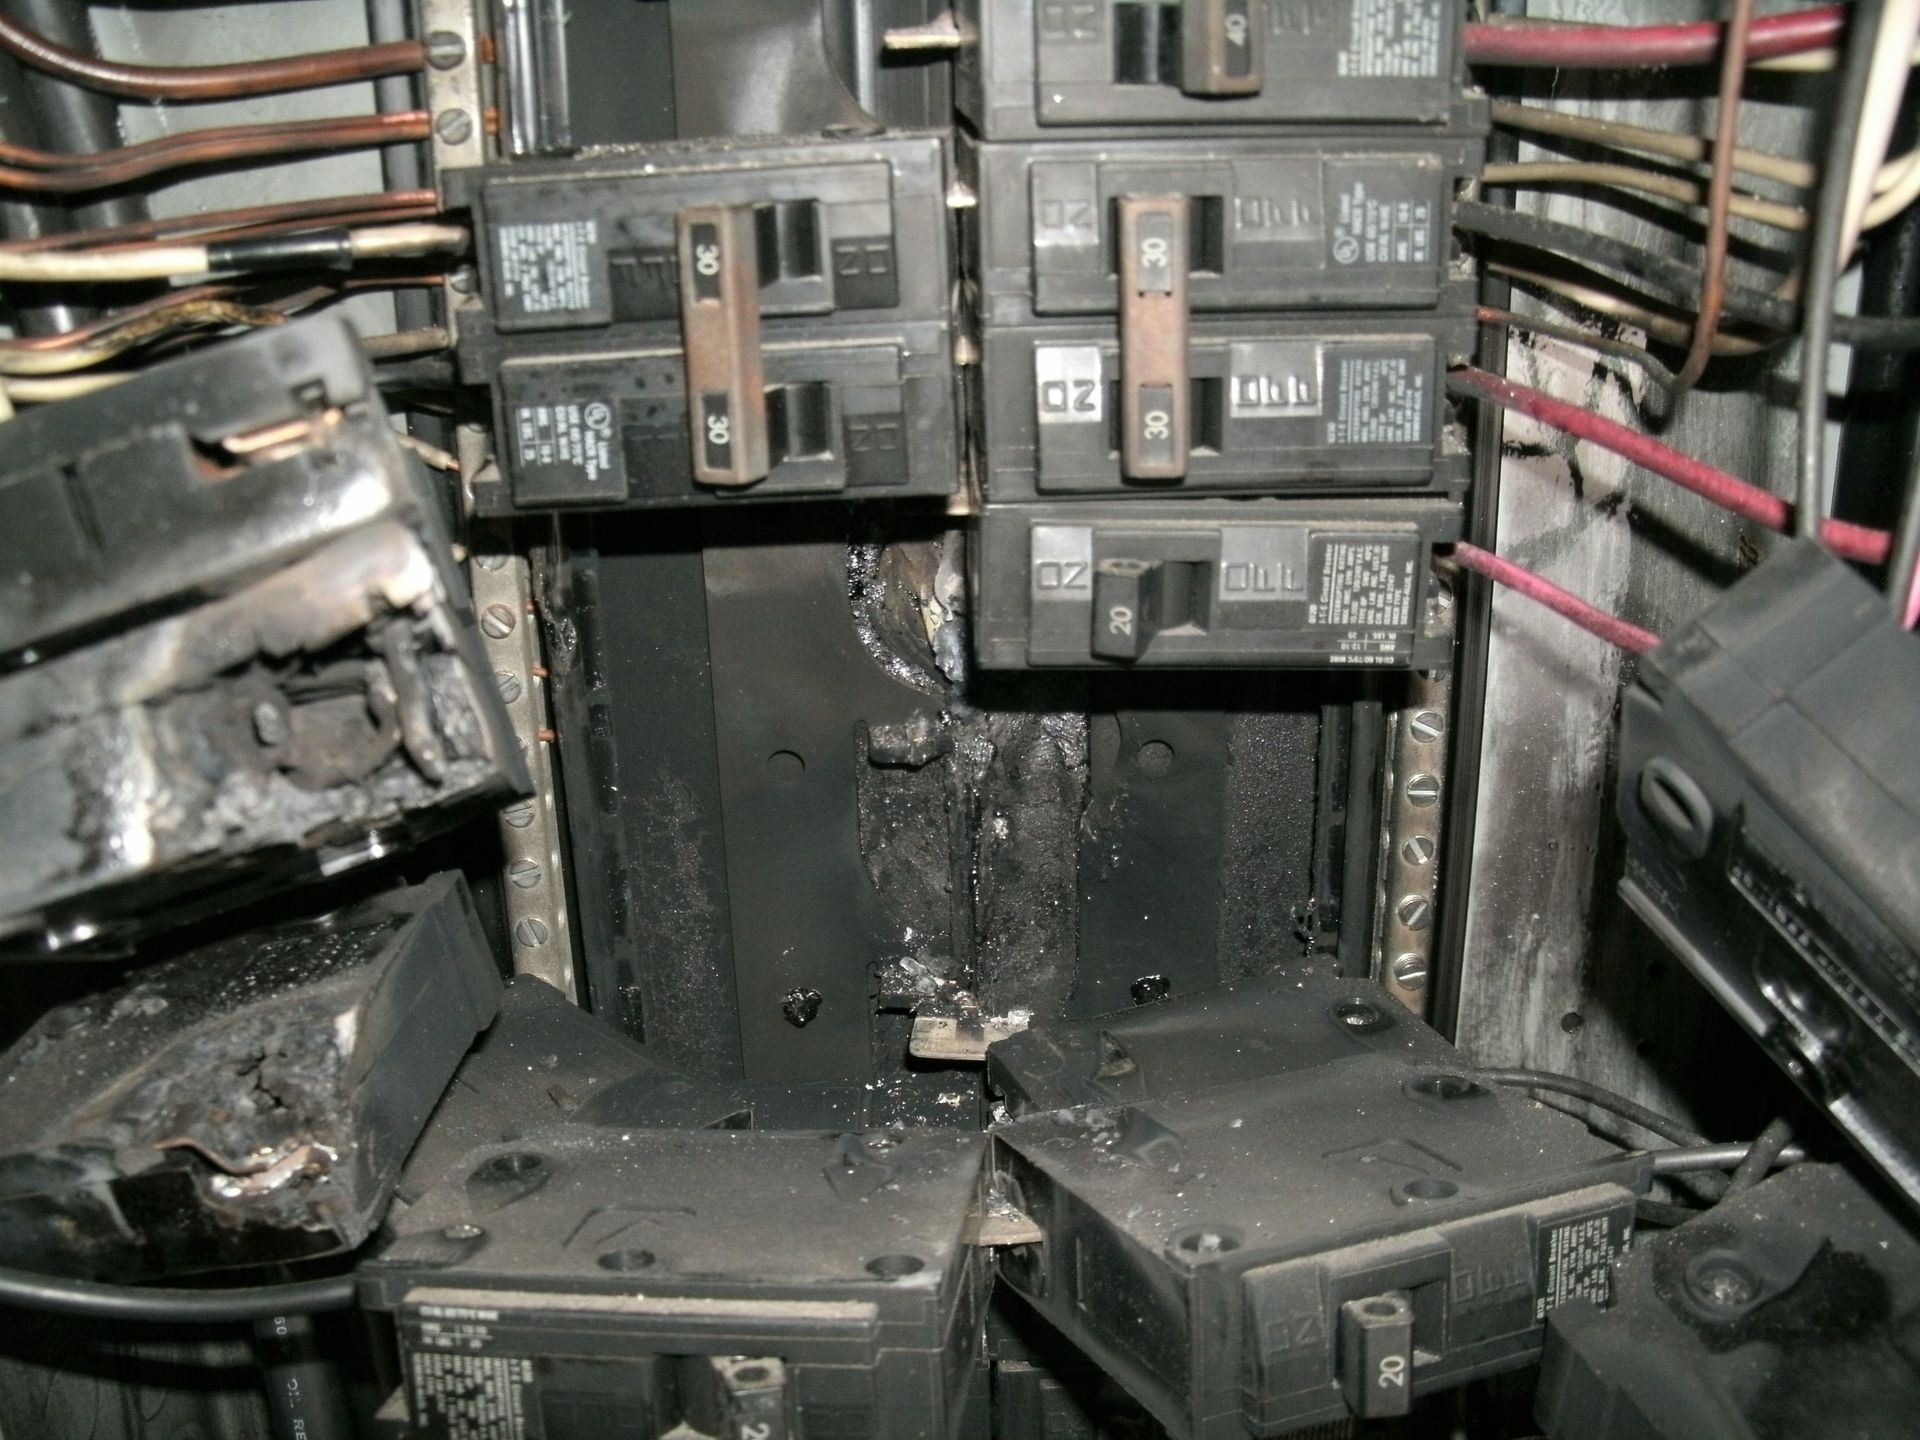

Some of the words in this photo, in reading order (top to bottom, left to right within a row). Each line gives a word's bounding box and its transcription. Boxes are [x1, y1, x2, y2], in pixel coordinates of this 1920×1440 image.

[1225, 13, 1247, 46] 40
[696, 244, 720, 275] 30
[1142, 237, 1168, 268] 30
[1041, 380, 1096, 413] ON
[707, 414, 730, 445] 30
[1144, 410, 1170, 440] 30
[1323, 544, 1332, 574] Breaker
[1037, 561, 1088, 591] ON
[1320, 577, 1330, 602] Circuit
[1110, 606, 1133, 636] 20
[1549, 1230, 1557, 1262] Breaker
[1547, 1265, 1556, 1293] Circuit
[1560, 1258, 1568, 1304] TERRUPTING
[1379, 1356, 1405, 1388] 20
[742, 1424, 770, 1440] 2
